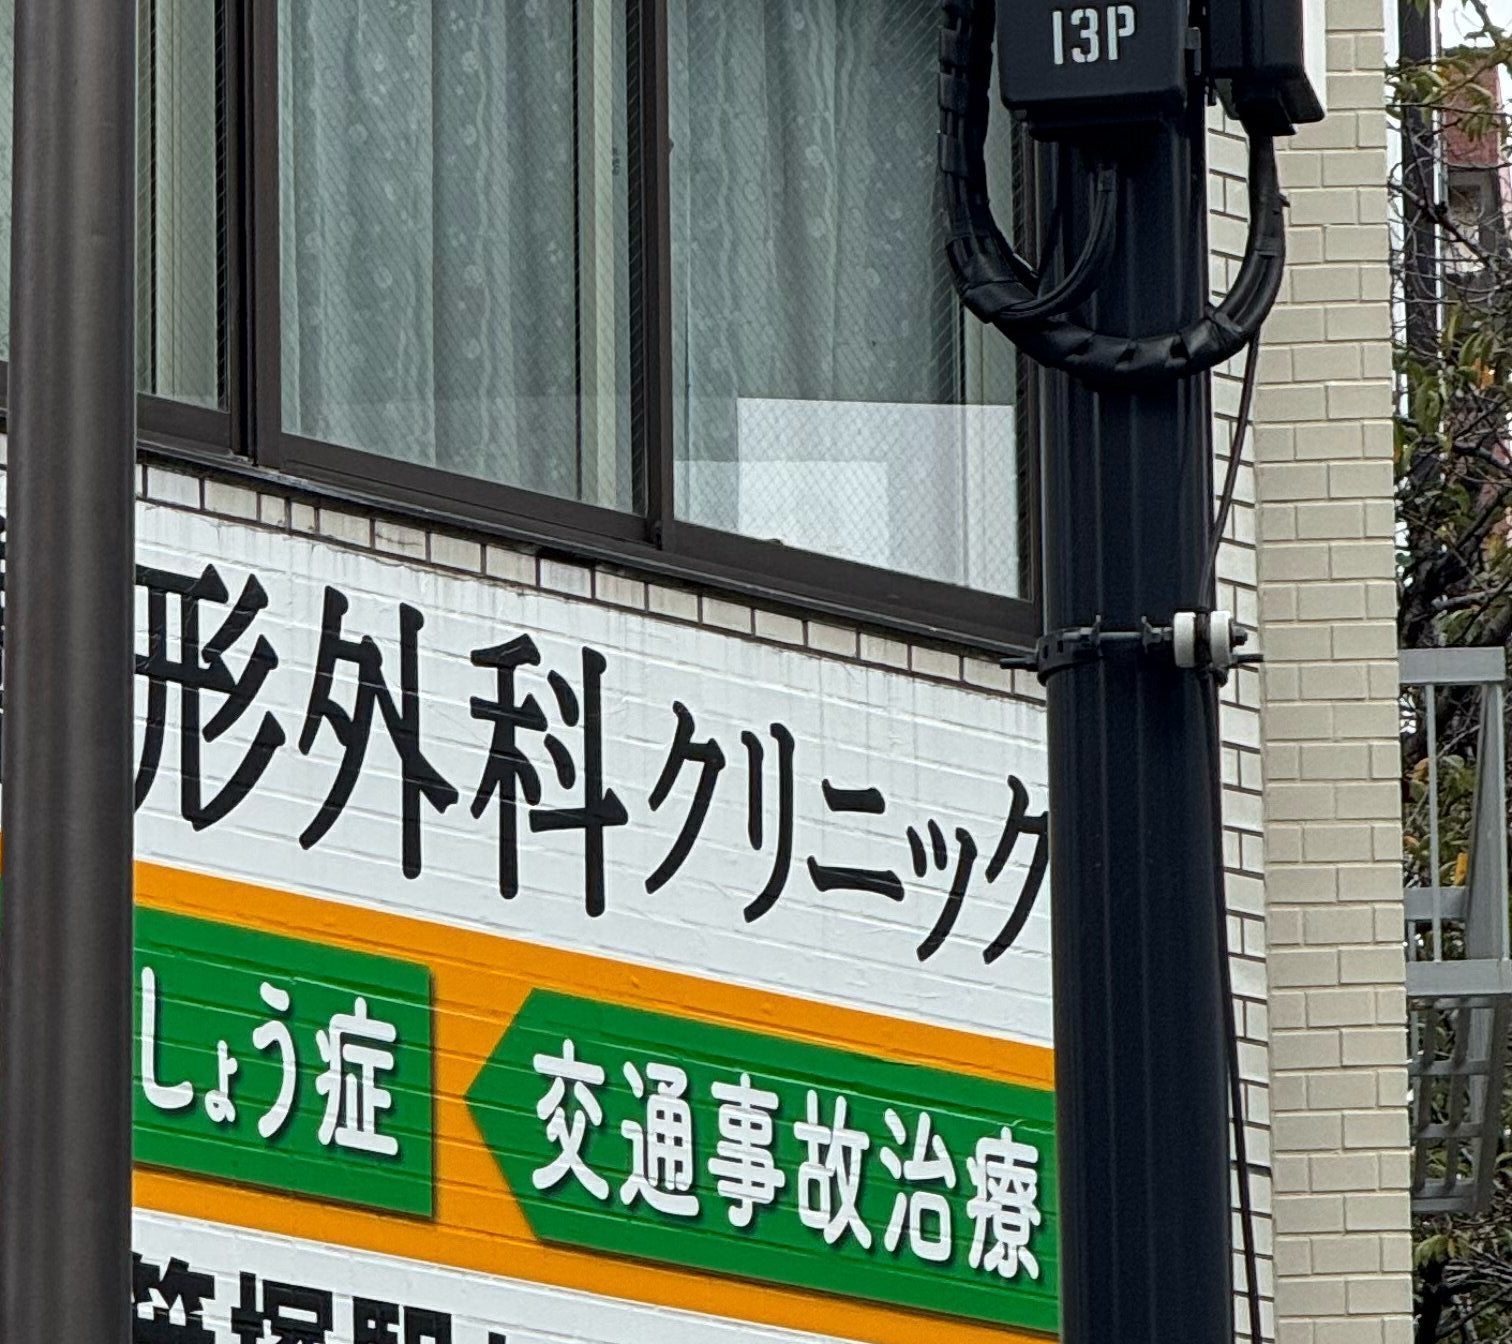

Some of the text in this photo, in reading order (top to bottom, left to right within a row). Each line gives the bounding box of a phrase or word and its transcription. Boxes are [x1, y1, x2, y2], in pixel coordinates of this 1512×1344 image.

[1051, 4, 1136, 65] 13P
[531, 1038, 1042, 1281] 交通事故治療
